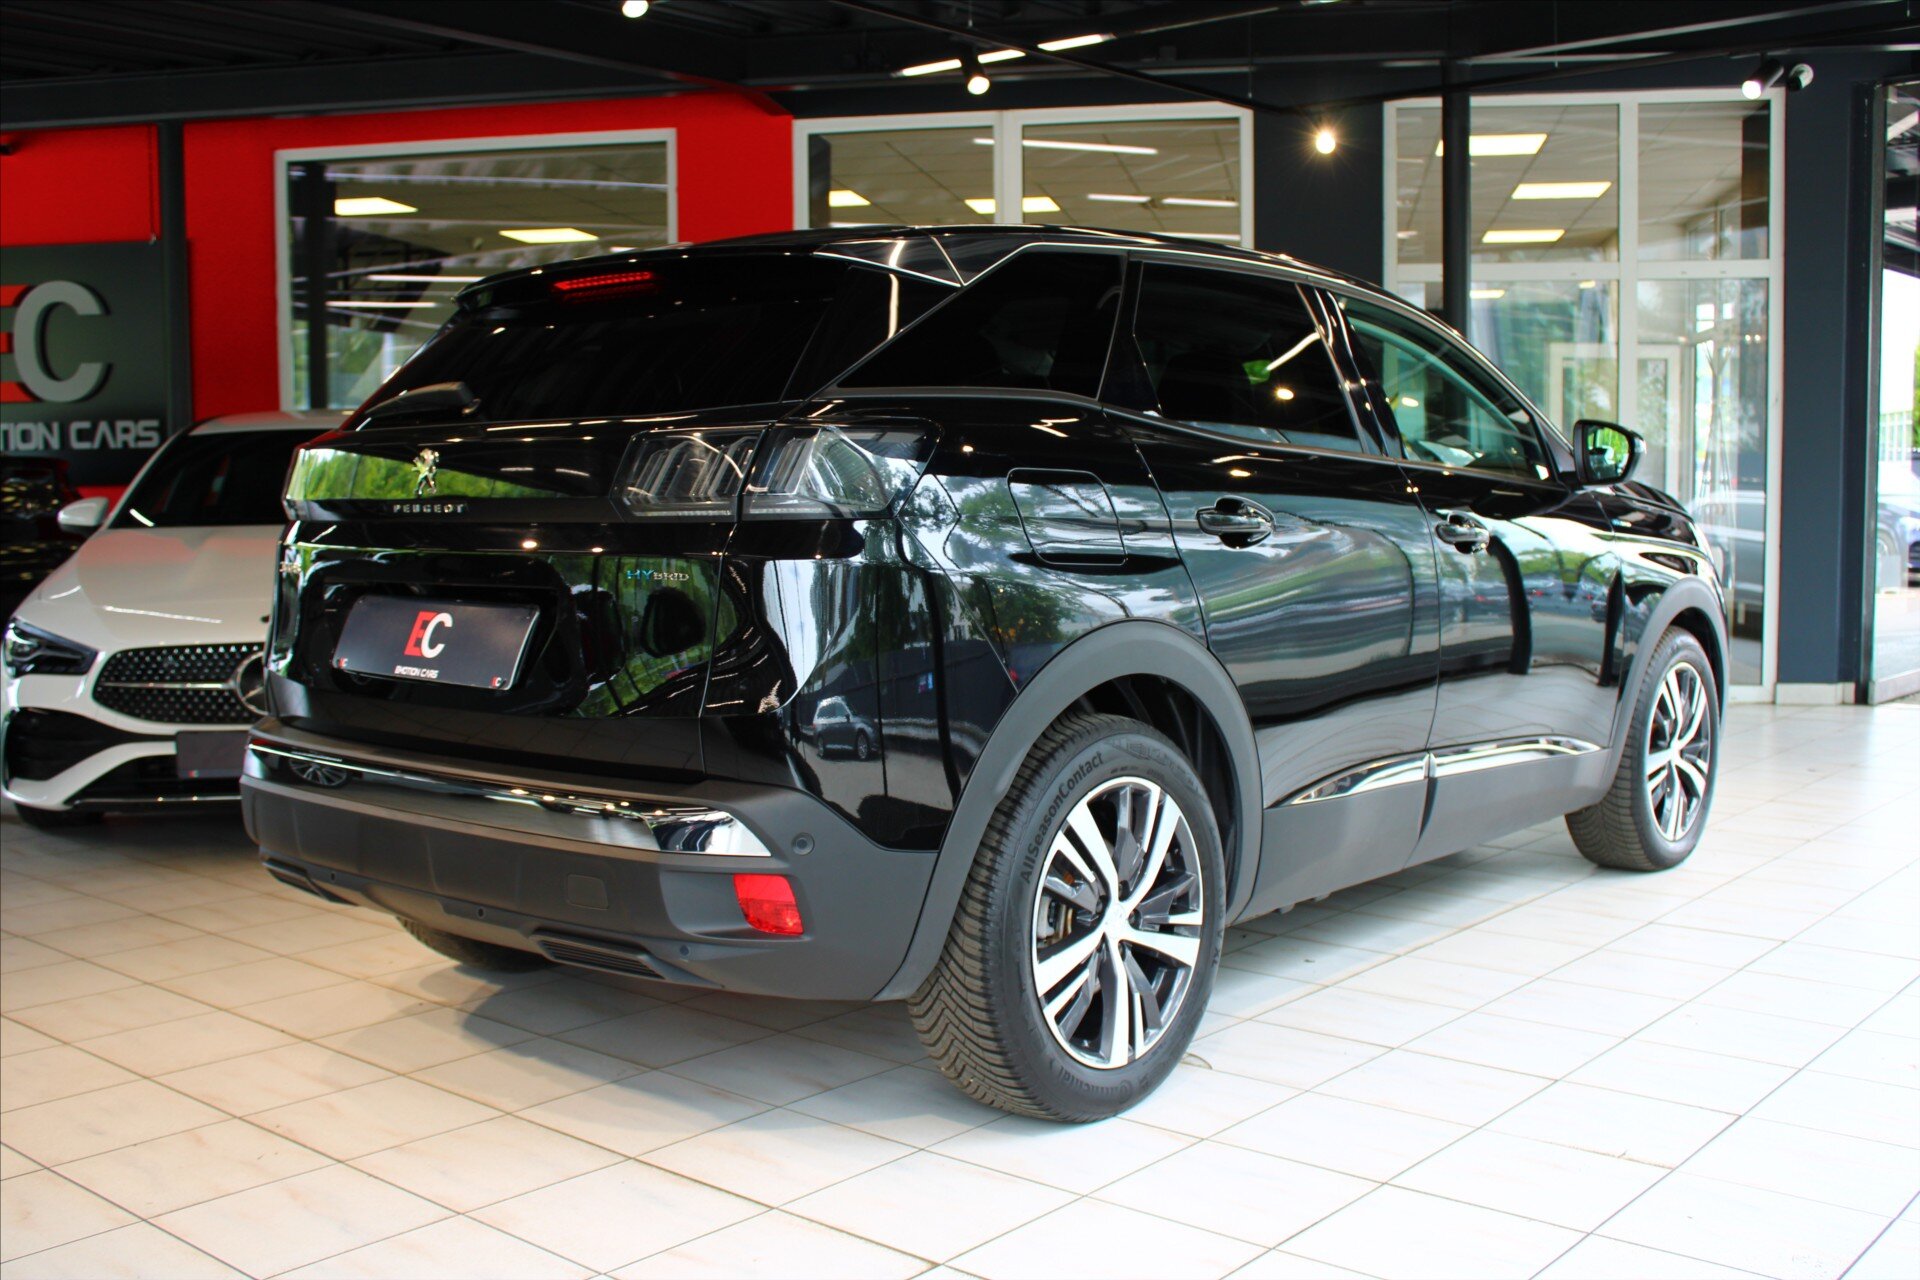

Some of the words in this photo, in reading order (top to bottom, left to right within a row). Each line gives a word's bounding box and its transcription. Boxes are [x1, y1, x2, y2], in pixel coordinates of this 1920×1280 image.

[69, 420, 159, 449] CARS
[393, 503, 465, 513] PEUGEOT
[404, 611, 453, 659] EC
[1020, 752, 1104, 884] AllSeasonContact
